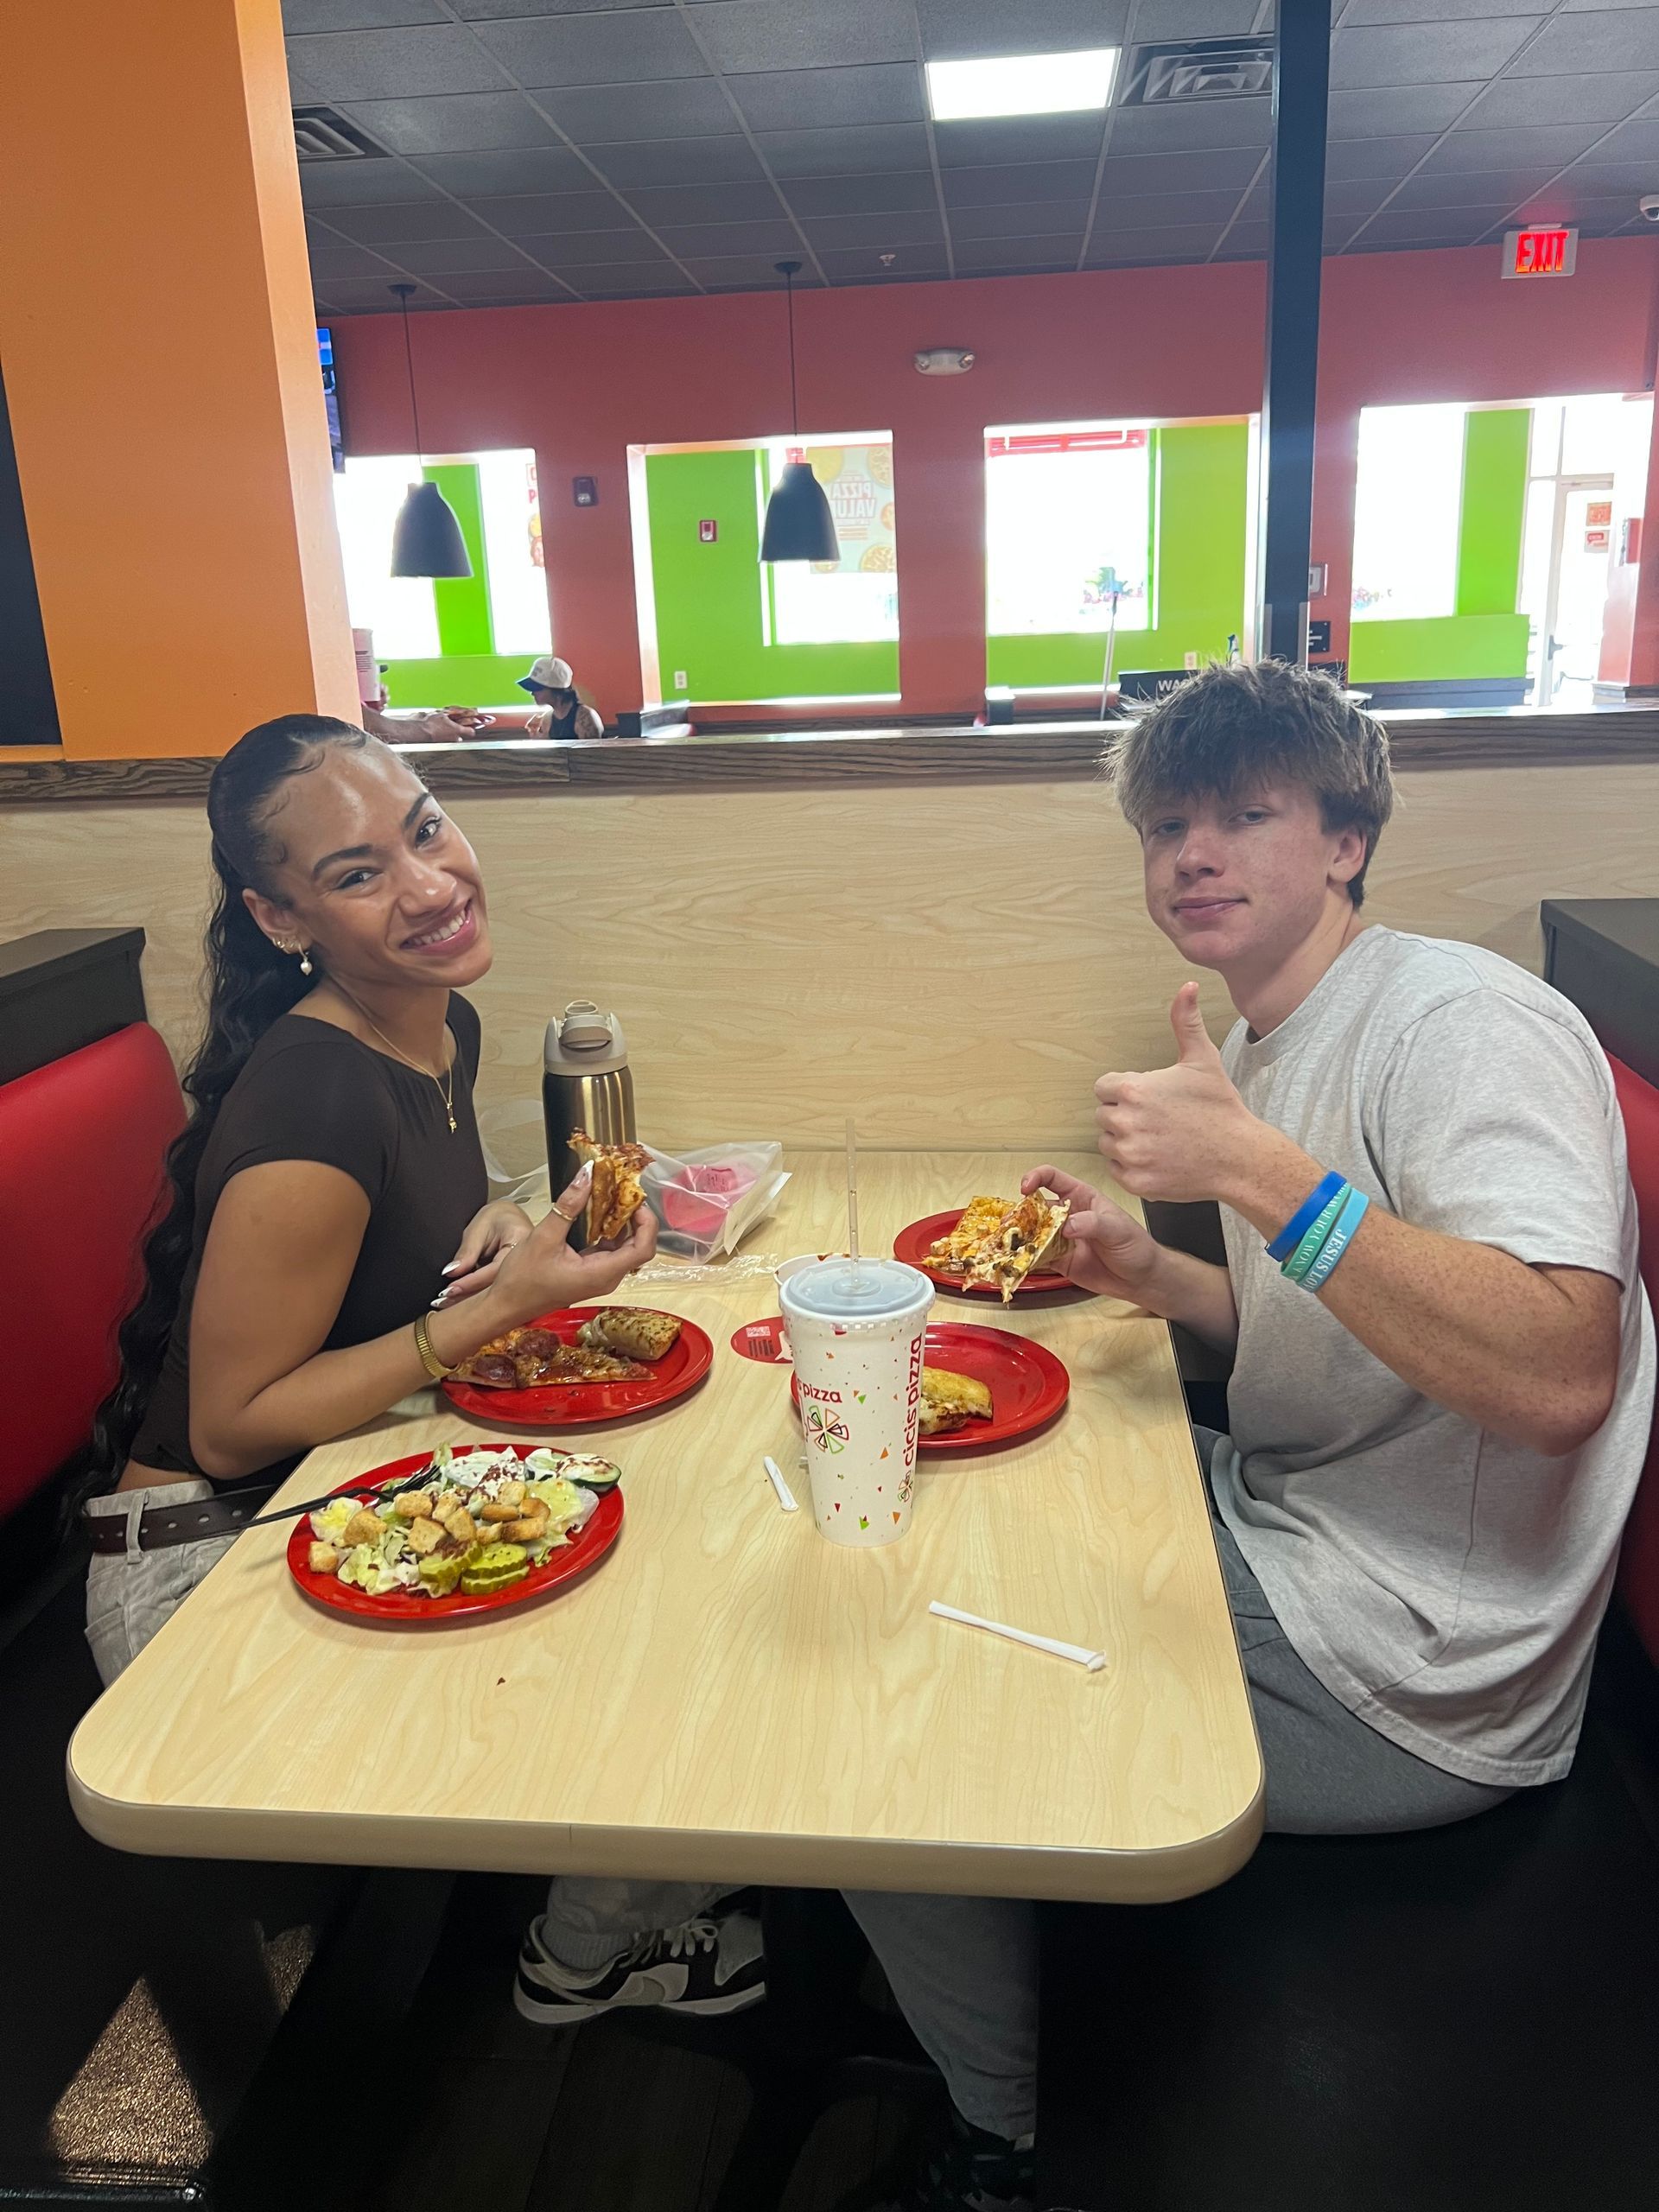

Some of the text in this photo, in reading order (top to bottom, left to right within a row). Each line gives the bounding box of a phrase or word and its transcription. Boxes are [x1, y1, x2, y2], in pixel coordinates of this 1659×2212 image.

[1516, 232, 1568, 273] EXIT
[1309, 1209, 1332, 1240] YOUR
[1303, 1229, 1347, 1289] JESUS LOV
[906, 1332, 922, 1407] pizza
[803, 1382, 843, 1404] pizza
